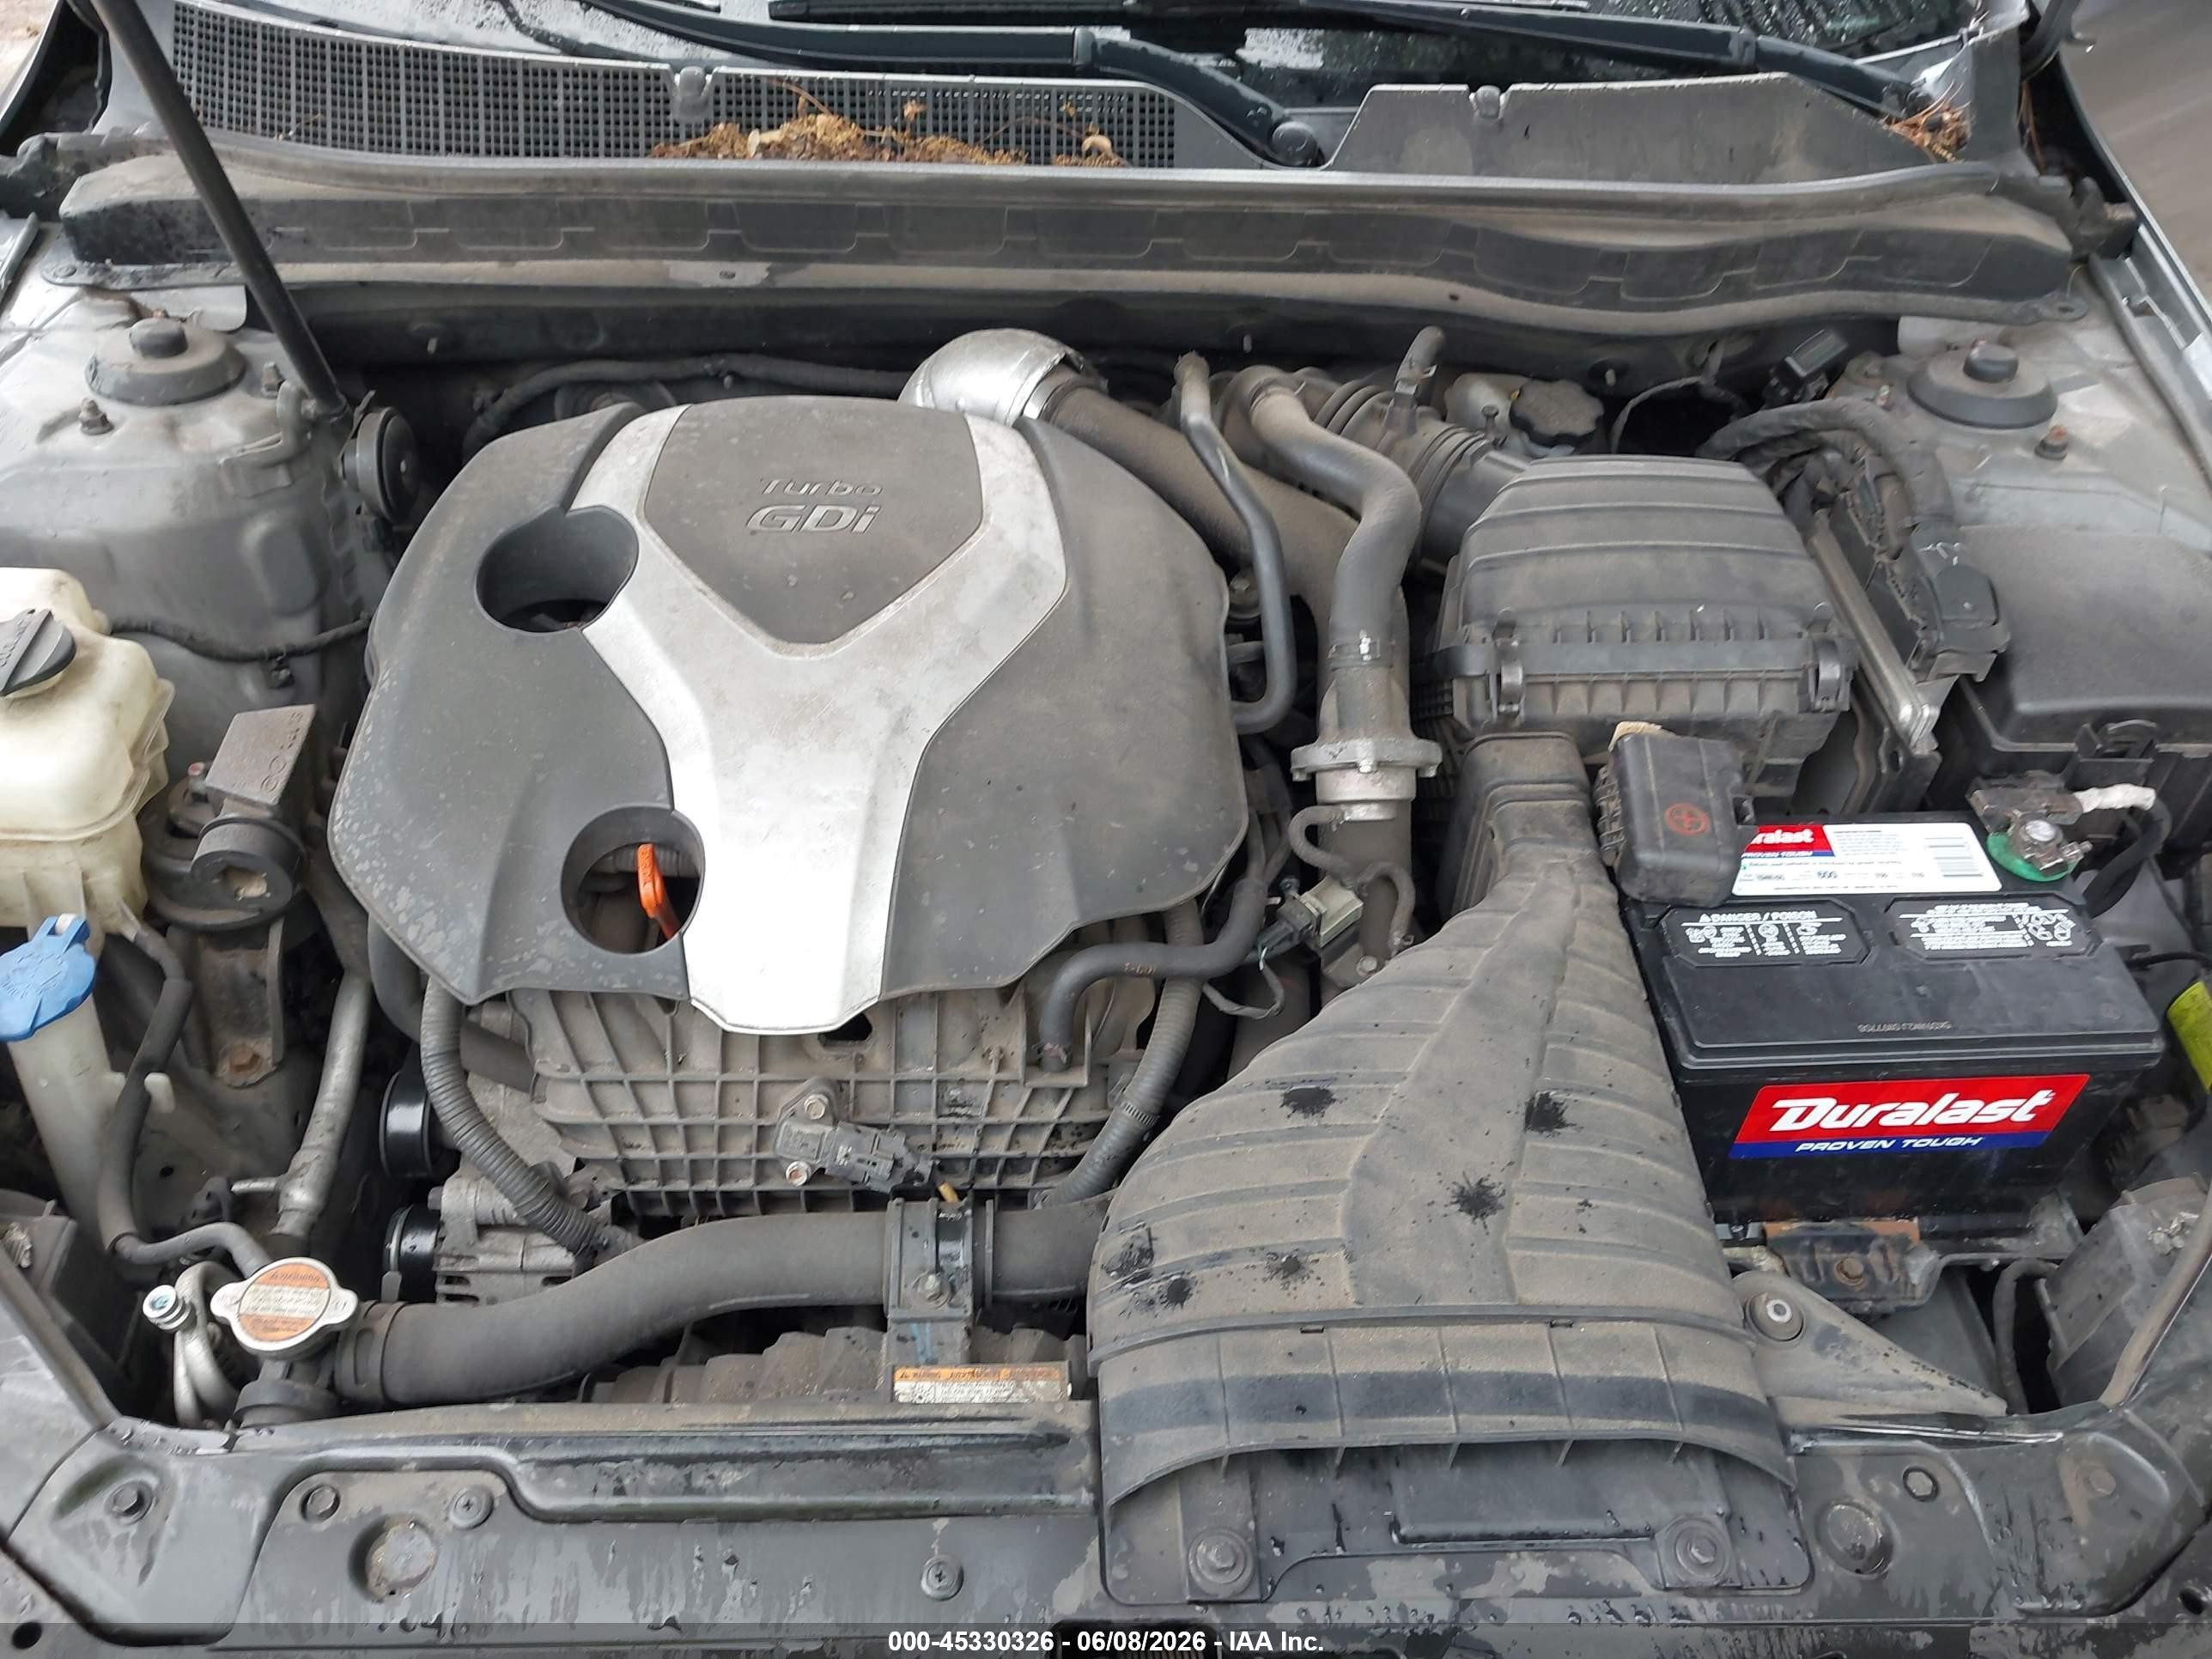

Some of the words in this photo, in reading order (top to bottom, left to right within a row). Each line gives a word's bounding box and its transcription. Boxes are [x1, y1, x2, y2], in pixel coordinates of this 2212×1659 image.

[761, 478, 884, 495] Turbo
[745, 504, 882, 534] GDi
[1750, 829, 1814, 845] ralast
[1711, 912, 1762, 922] DANGER
[1771, 910, 1818, 921] POISON
[1769, 1090, 2054, 1132] Duralast
[1796, 1138, 1898, 1152] PROVEN
[1901, 1136, 1982, 1149] TOUGH
